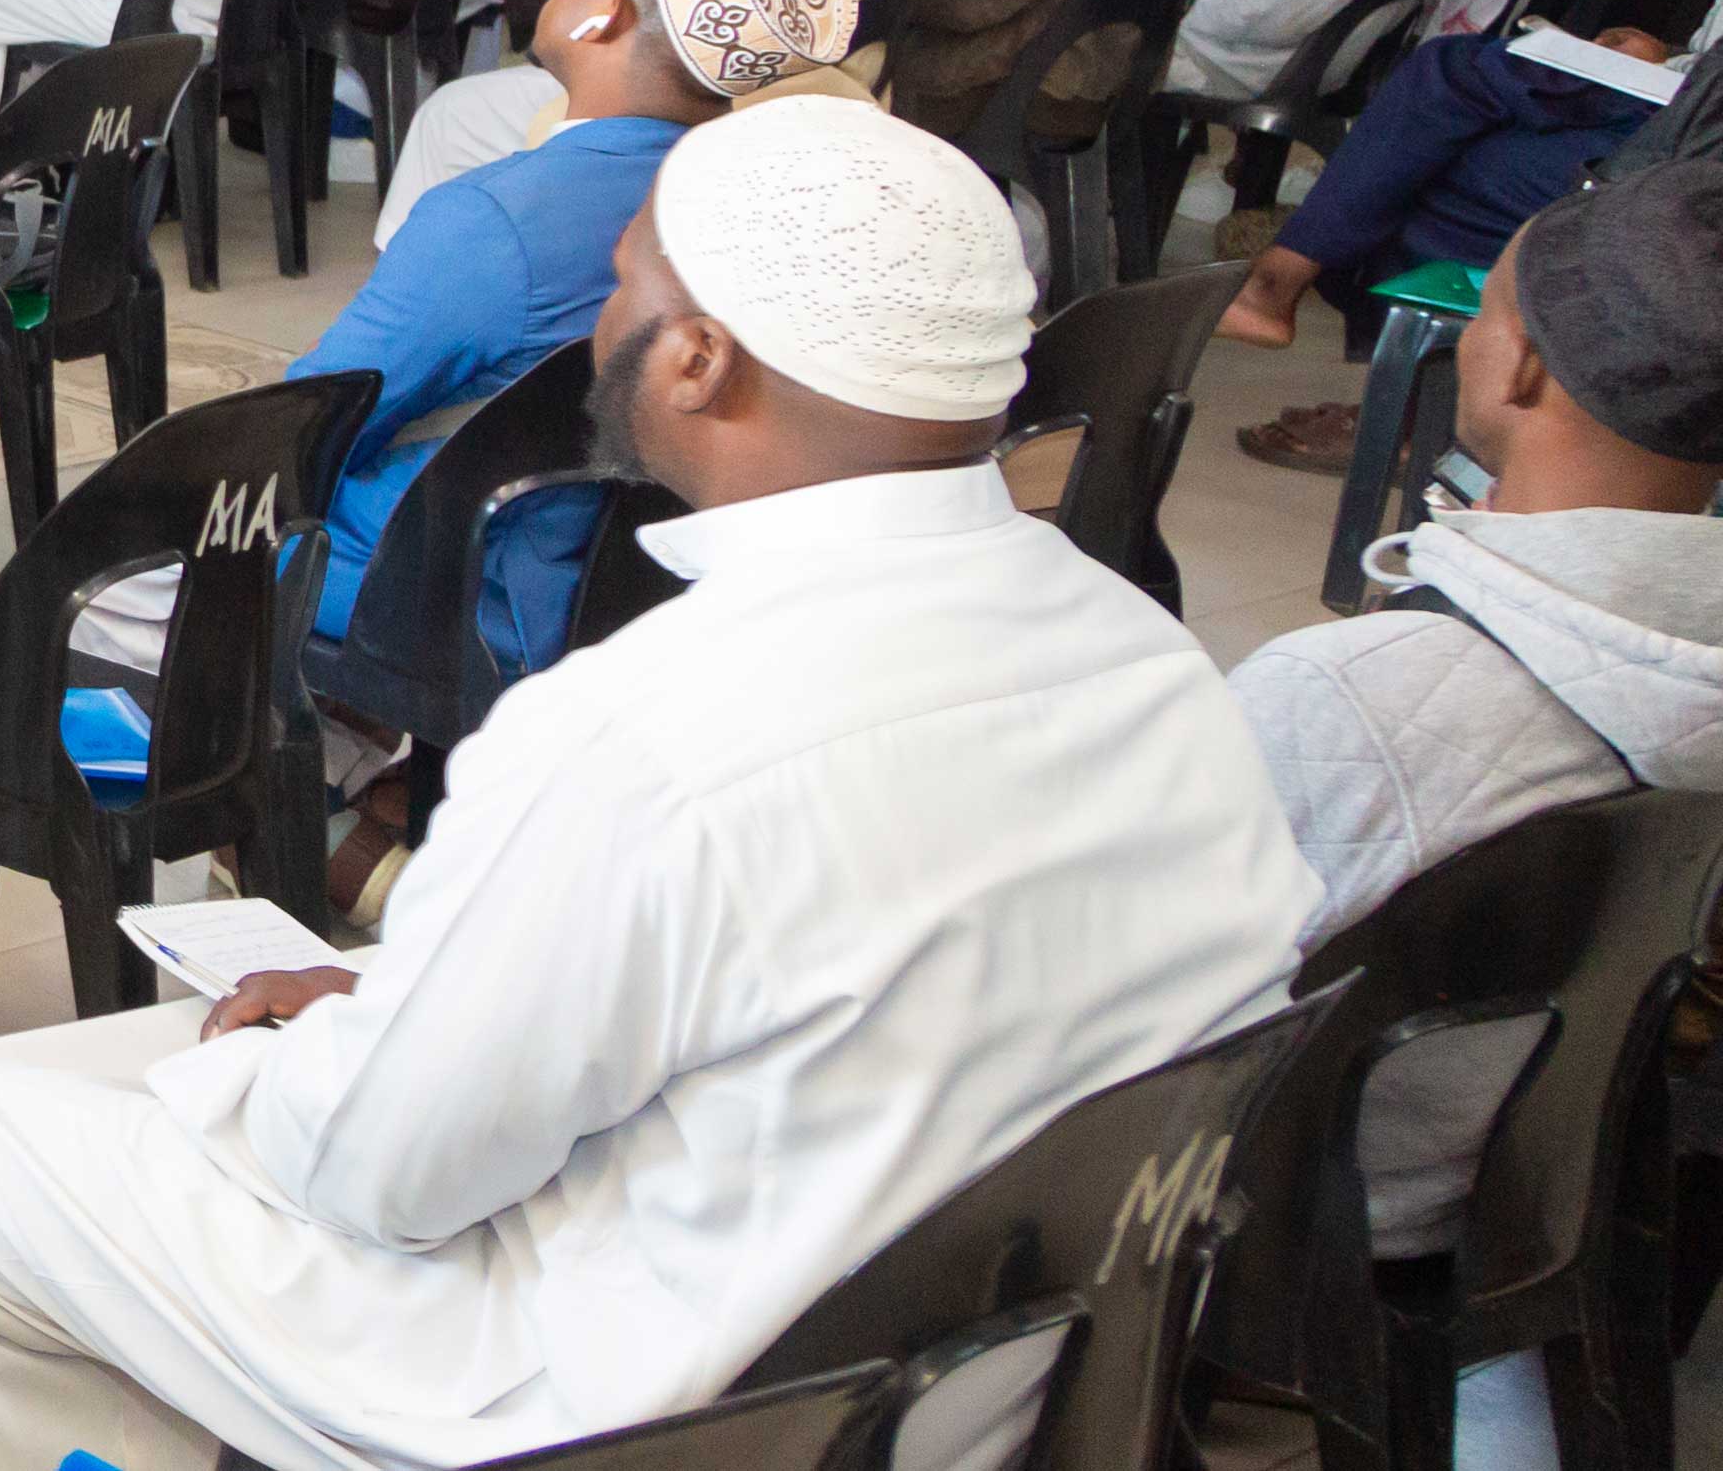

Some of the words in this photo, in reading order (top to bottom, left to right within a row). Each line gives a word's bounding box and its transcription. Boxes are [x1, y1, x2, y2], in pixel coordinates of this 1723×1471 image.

[82, 105, 132, 157] MA
[195, 472, 278, 558] MA
[1095, 1126, 1234, 1285] MA
